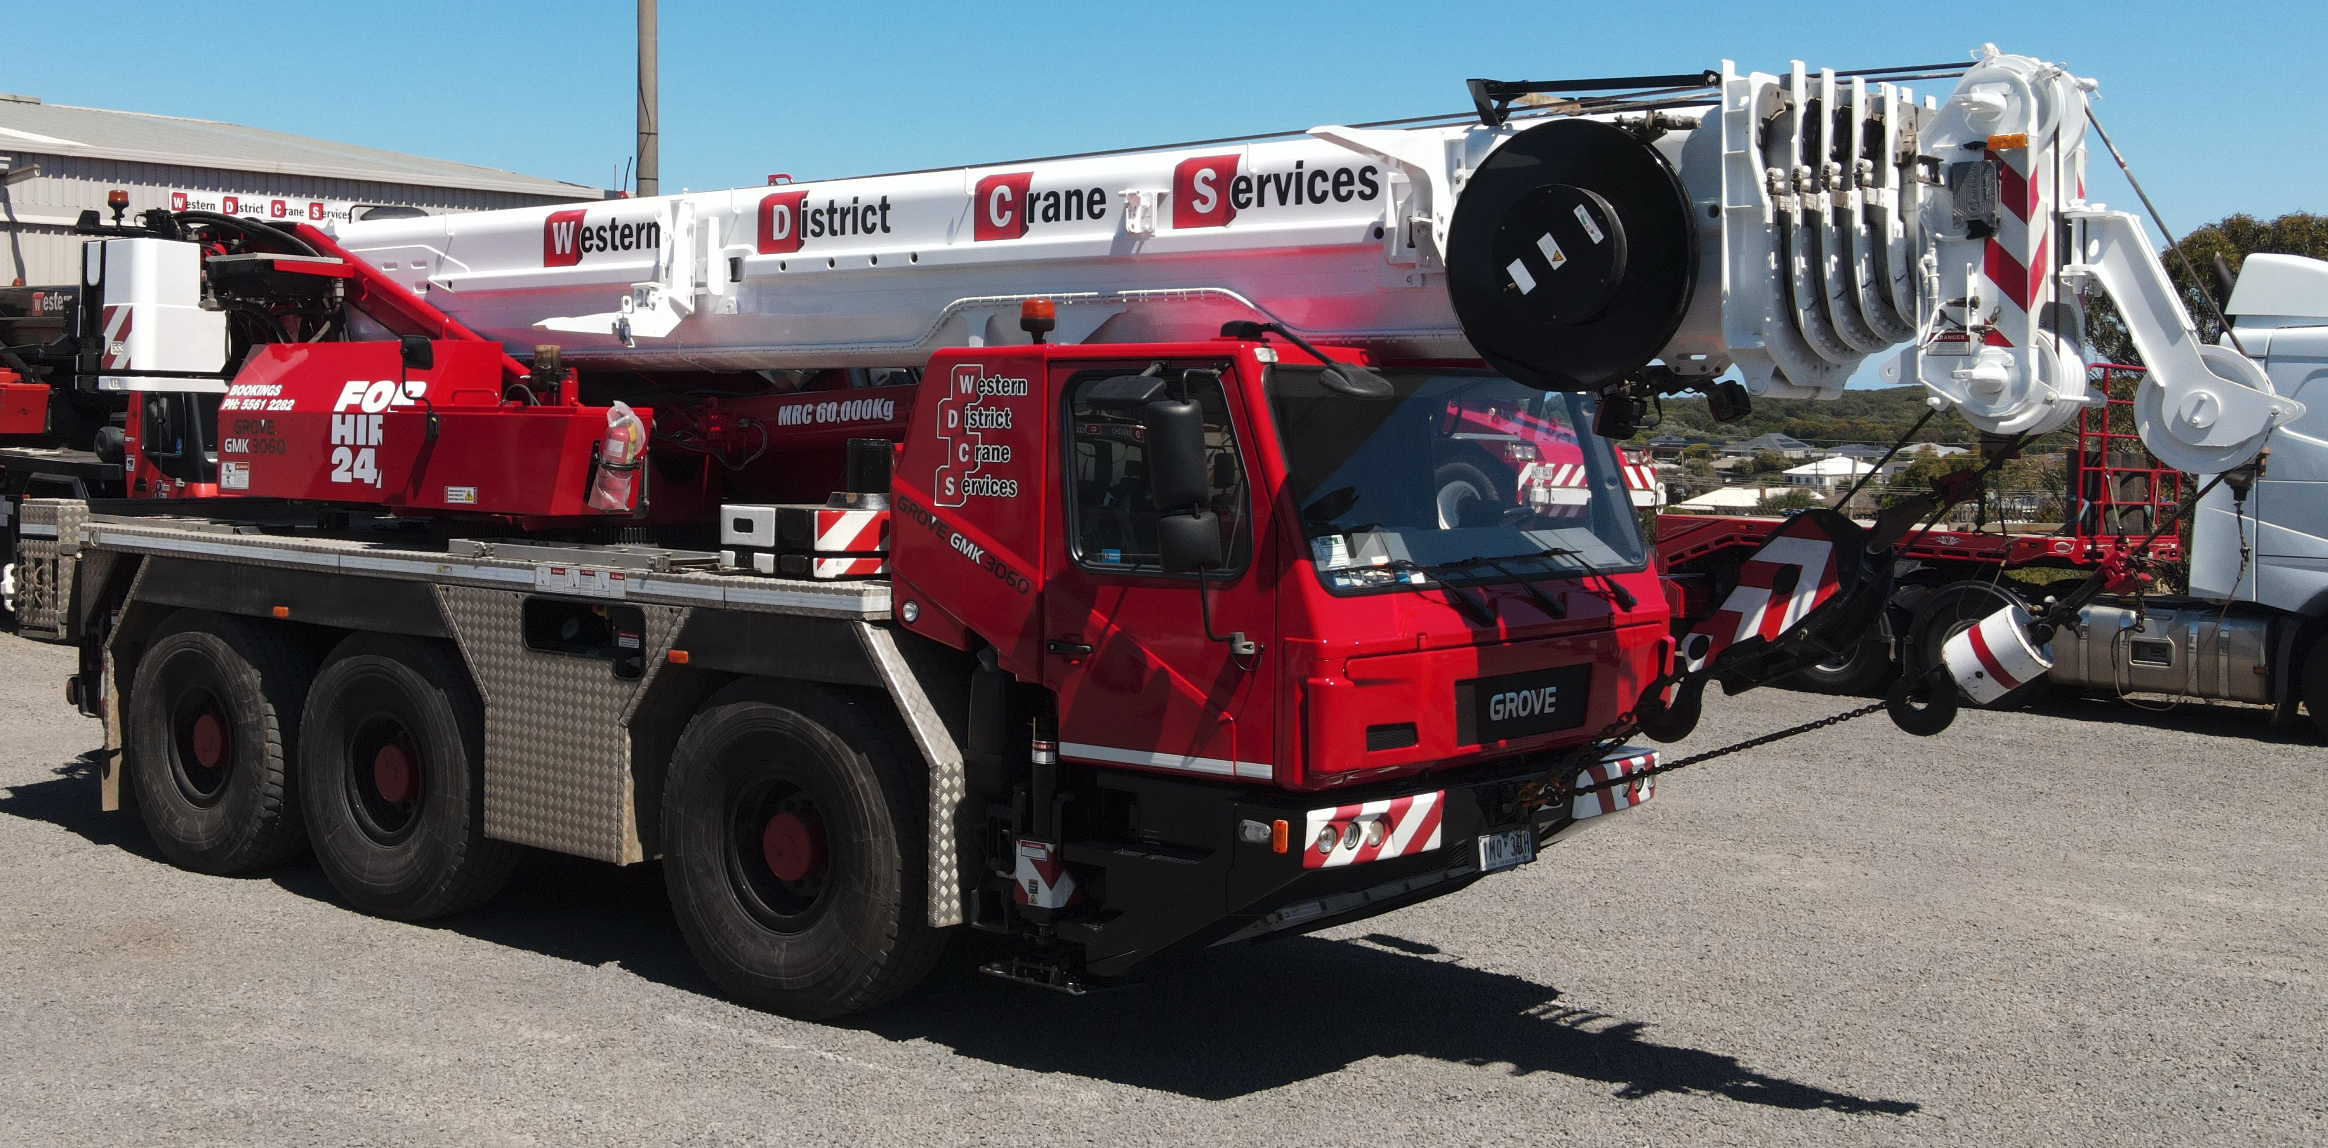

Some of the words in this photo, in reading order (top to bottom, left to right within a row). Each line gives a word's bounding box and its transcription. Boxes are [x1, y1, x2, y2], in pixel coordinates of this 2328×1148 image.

[173, 197, 216, 211] Western
[226, 200, 264, 214] District
[274, 204, 305, 217] Crane
[312, 206, 353, 221] Services
[553, 217, 660, 255] Western
[772, 195, 891, 241] District
[989, 184, 1107, 228] Crane
[1191, 160, 1380, 214] Services
[228, 384, 283, 397] BOOKINGS
[959, 373, 1028, 396] Western
[221, 398, 240, 411] PH:
[240, 398, 265, 411] 5561
[266, 398, 295, 411] 2282
[333, 380, 427, 413] FOR
[777, 403, 814, 426] MRC
[815, 397, 895, 425] 60,000Kg
[947, 406, 1012, 429] District
[233, 419, 275, 436] GROVE
[224, 438, 250, 454] GMK
[251, 438, 286, 455] 3060
[958, 442, 1012, 463] Crane
[944, 474, 1018, 497] Services
[897, 495, 949, 542] GROVE
[950, 532, 985, 565] GMK
[984, 554, 1031, 595] 3060
[1489, 686, 1557, 722] GROVE
